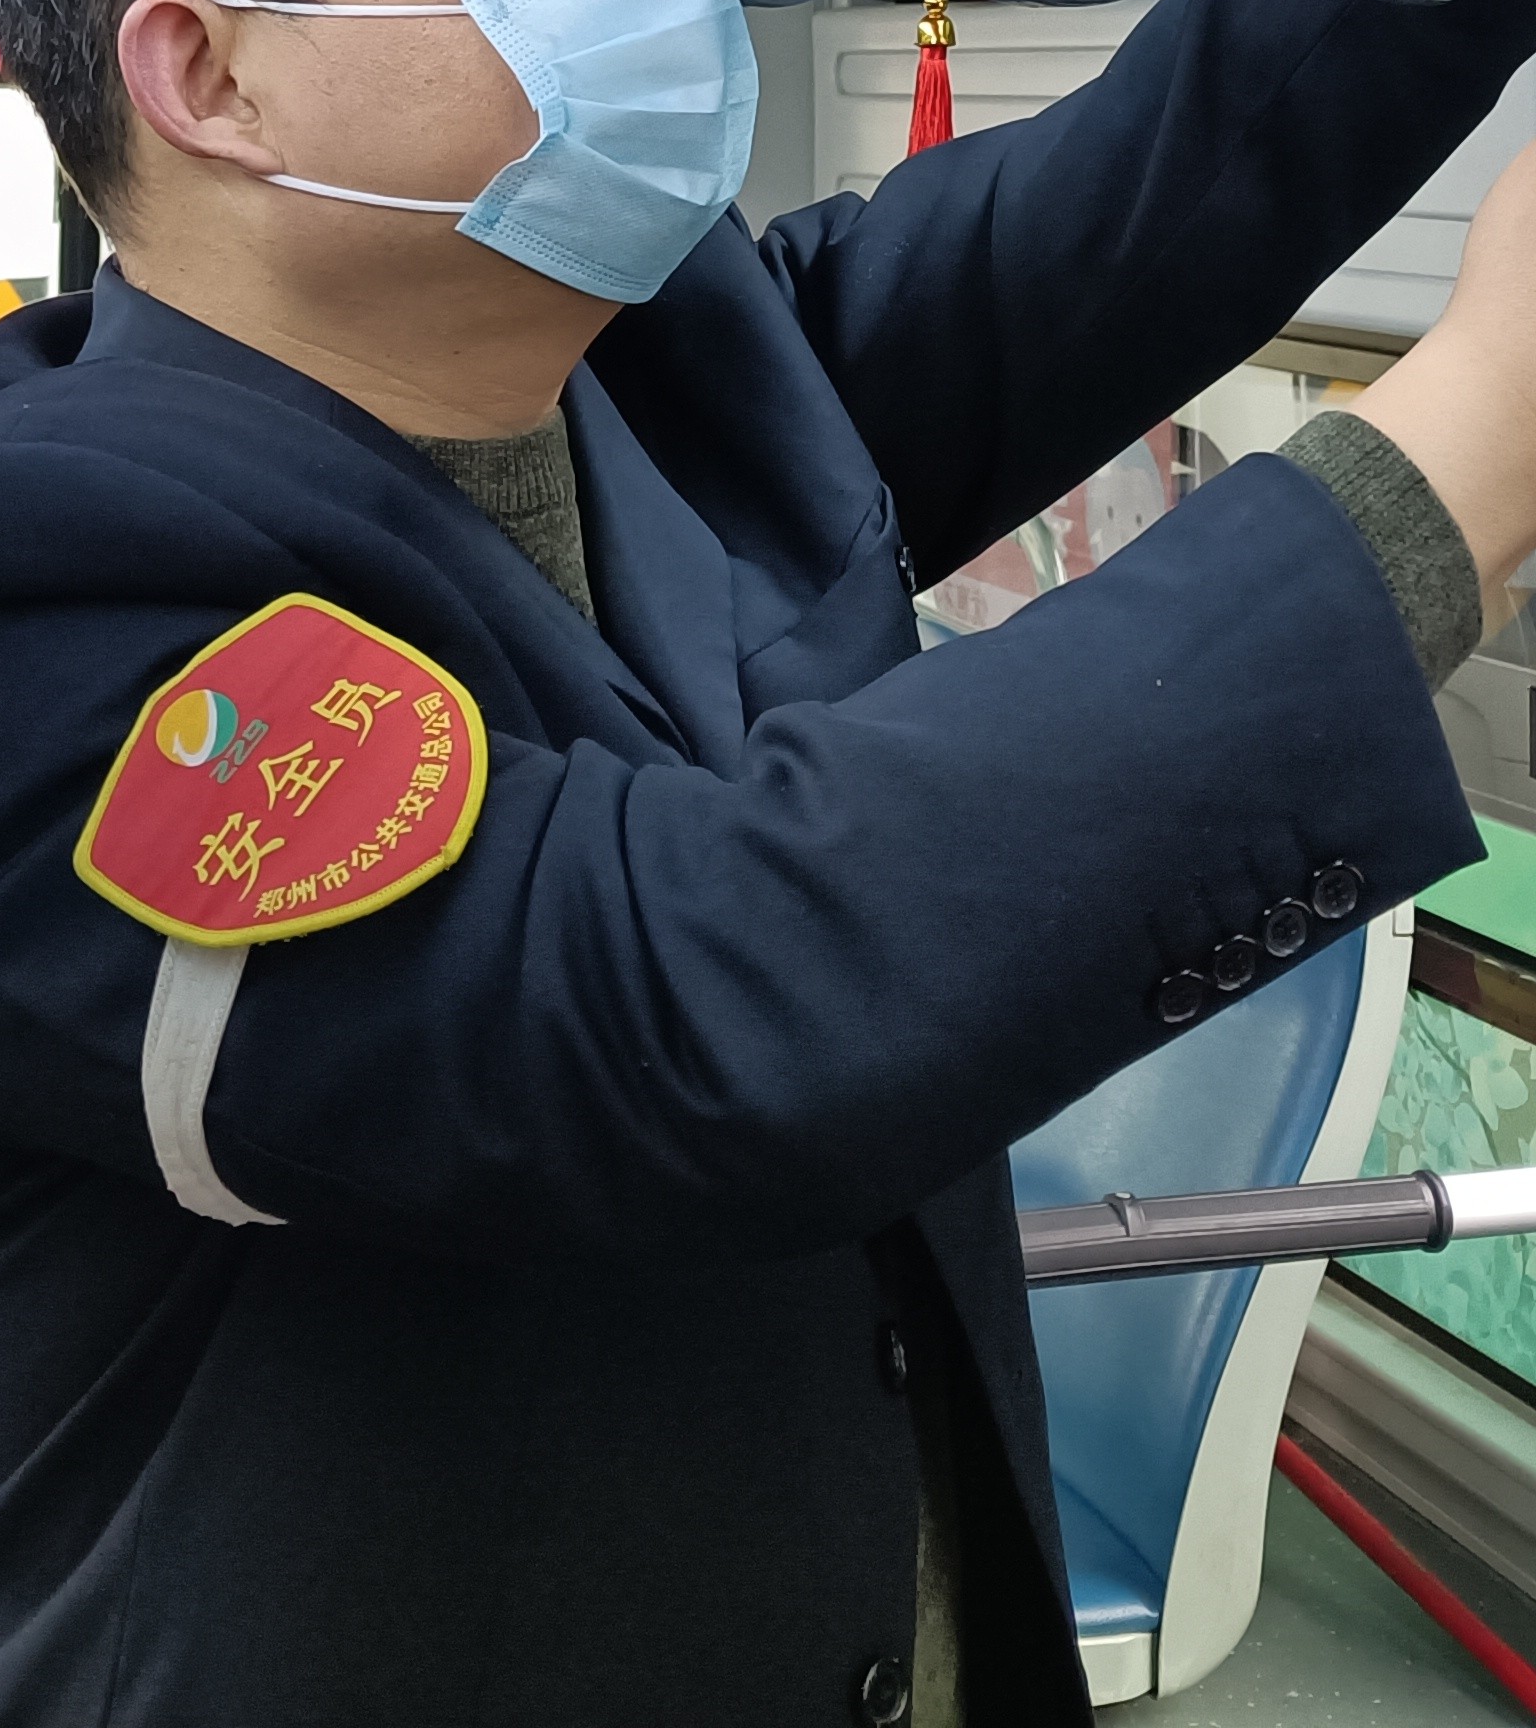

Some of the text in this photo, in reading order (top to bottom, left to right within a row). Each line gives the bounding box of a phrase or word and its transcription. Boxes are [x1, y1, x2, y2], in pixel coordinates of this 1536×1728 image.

[192, 678, 403, 903] 安全员
[252, 691, 453, 919] 郑州市公共交通总公司
